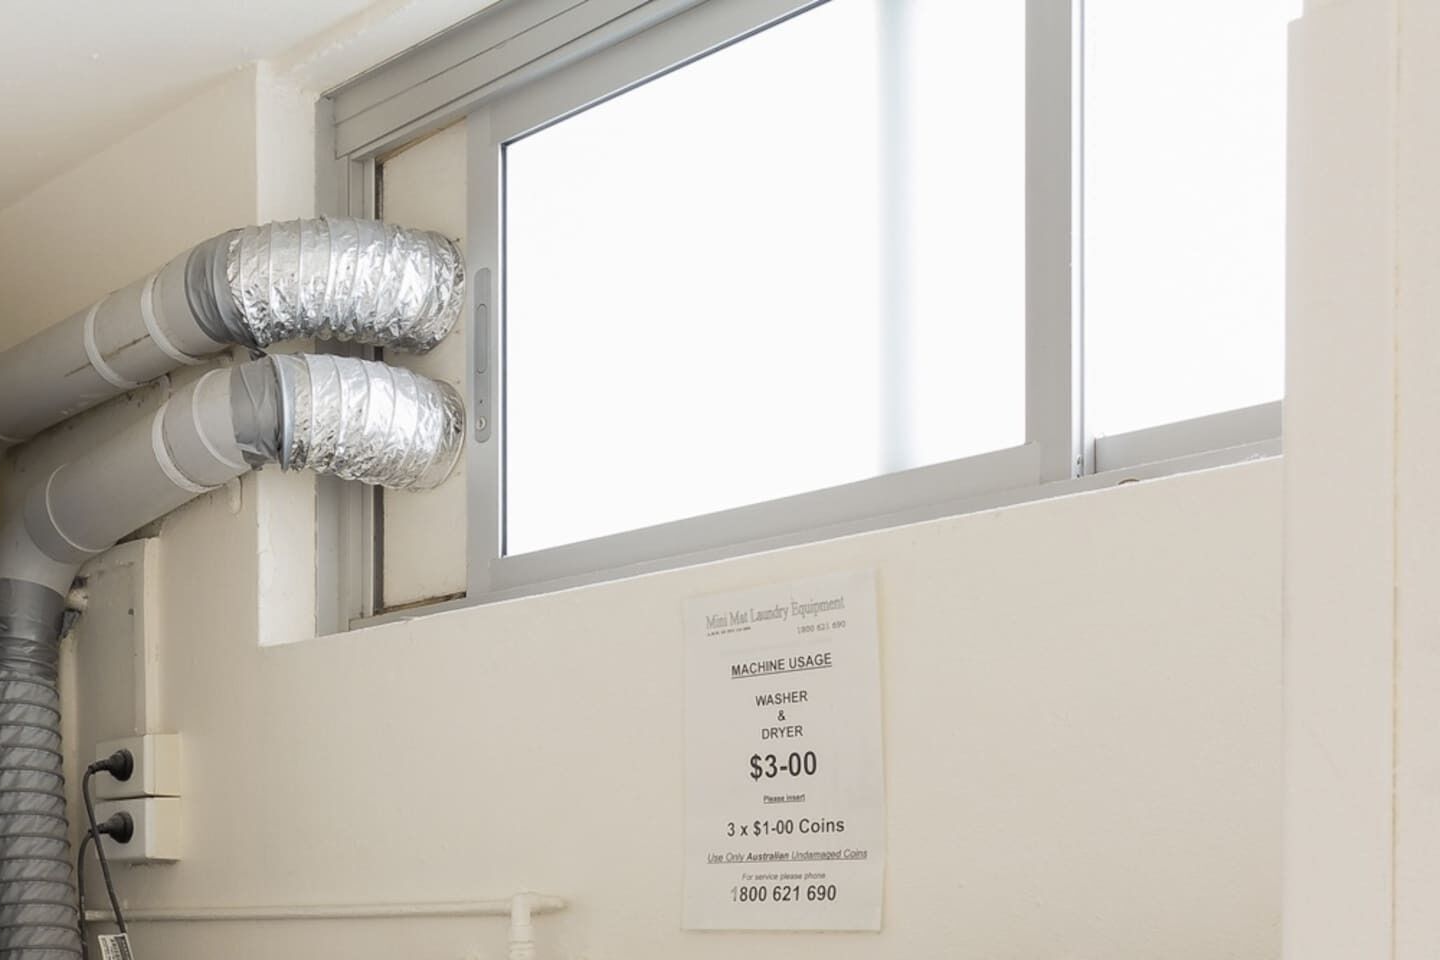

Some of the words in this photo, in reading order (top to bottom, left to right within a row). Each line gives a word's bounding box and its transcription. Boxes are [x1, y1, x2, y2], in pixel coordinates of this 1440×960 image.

[751, 604, 789, 623] Laundry
[791, 596, 846, 619] Equipment
[731, 658, 785, 677] MACHINE
[789, 652, 832, 671] USAGE
[755, 690, 808, 707] WASHER
[777, 710, 786, 722] &
[761, 725, 803, 740] DRYER
[750, 750, 817, 782] $3-00
[727, 822, 735, 837] 3
[740, 825, 748, 836] x
[753, 819, 794, 837] $1-00
[799, 817, 845, 834] Coins
[707, 852, 723, 863] Use
[725, 853, 744, 863] Only
[747, 851, 789, 862] Australian
[792, 849, 841, 861] Undamaged
[844, 848, 868, 860] Coins
[804, 871, 826, 881] phone
[730, 885, 767, 902] 1800
[772, 885, 800, 901] 621
[807, 884, 837, 901] 690
